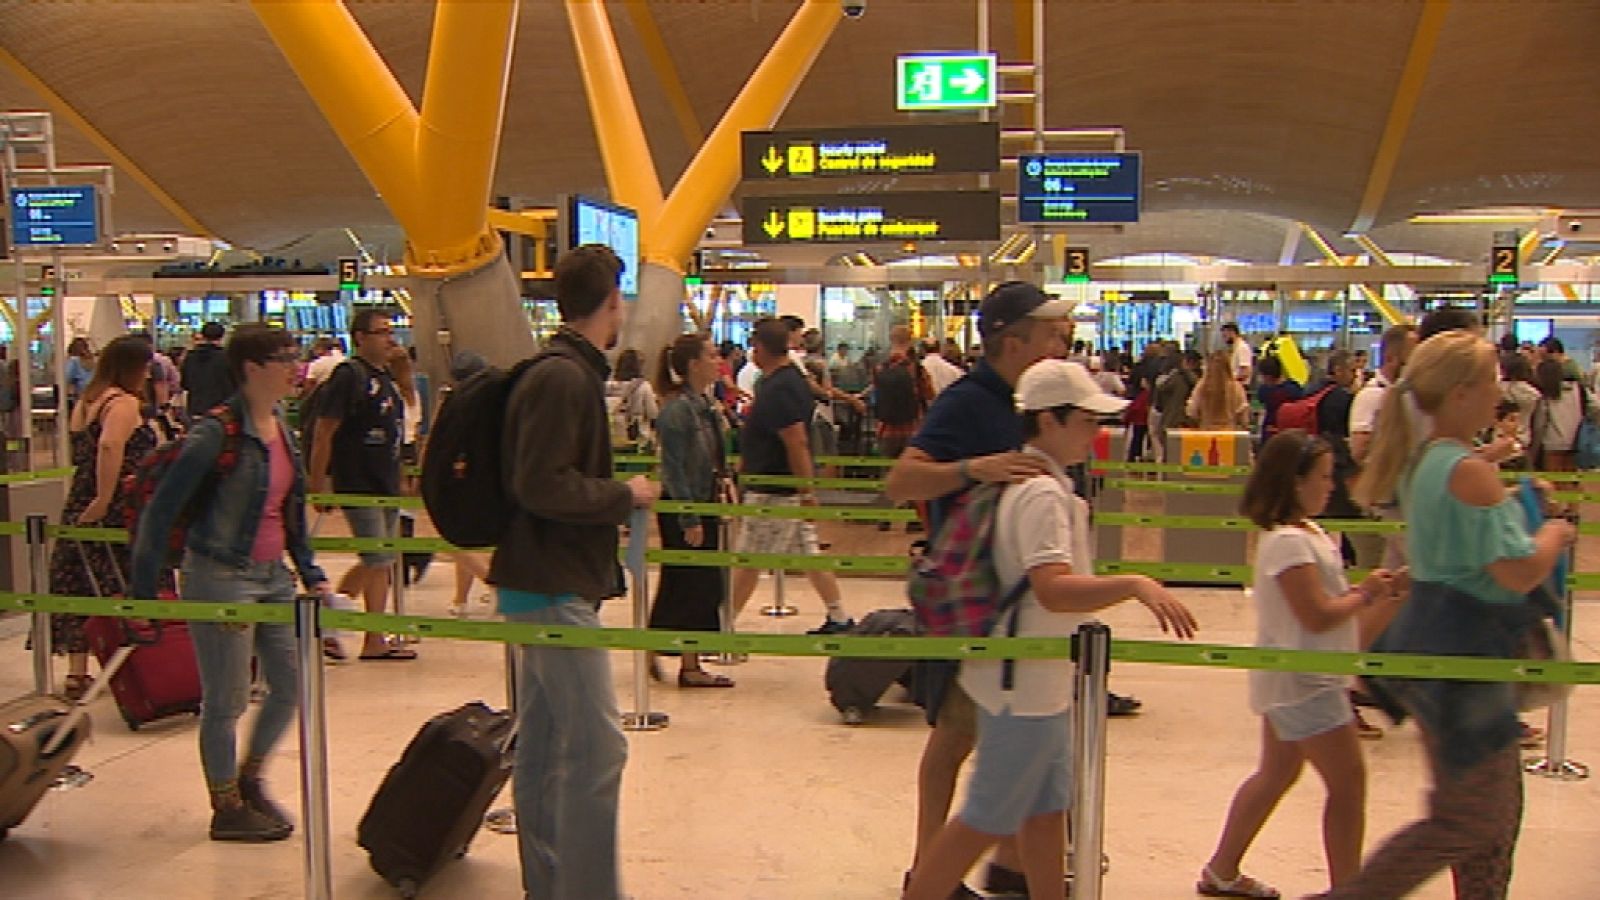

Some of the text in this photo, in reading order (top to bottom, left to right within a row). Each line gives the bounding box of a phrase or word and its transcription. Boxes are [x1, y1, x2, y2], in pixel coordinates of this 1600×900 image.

[1069, 252, 1085, 273] 3
[1496, 249, 1514, 273] 2
[342, 262, 356, 282] 5
